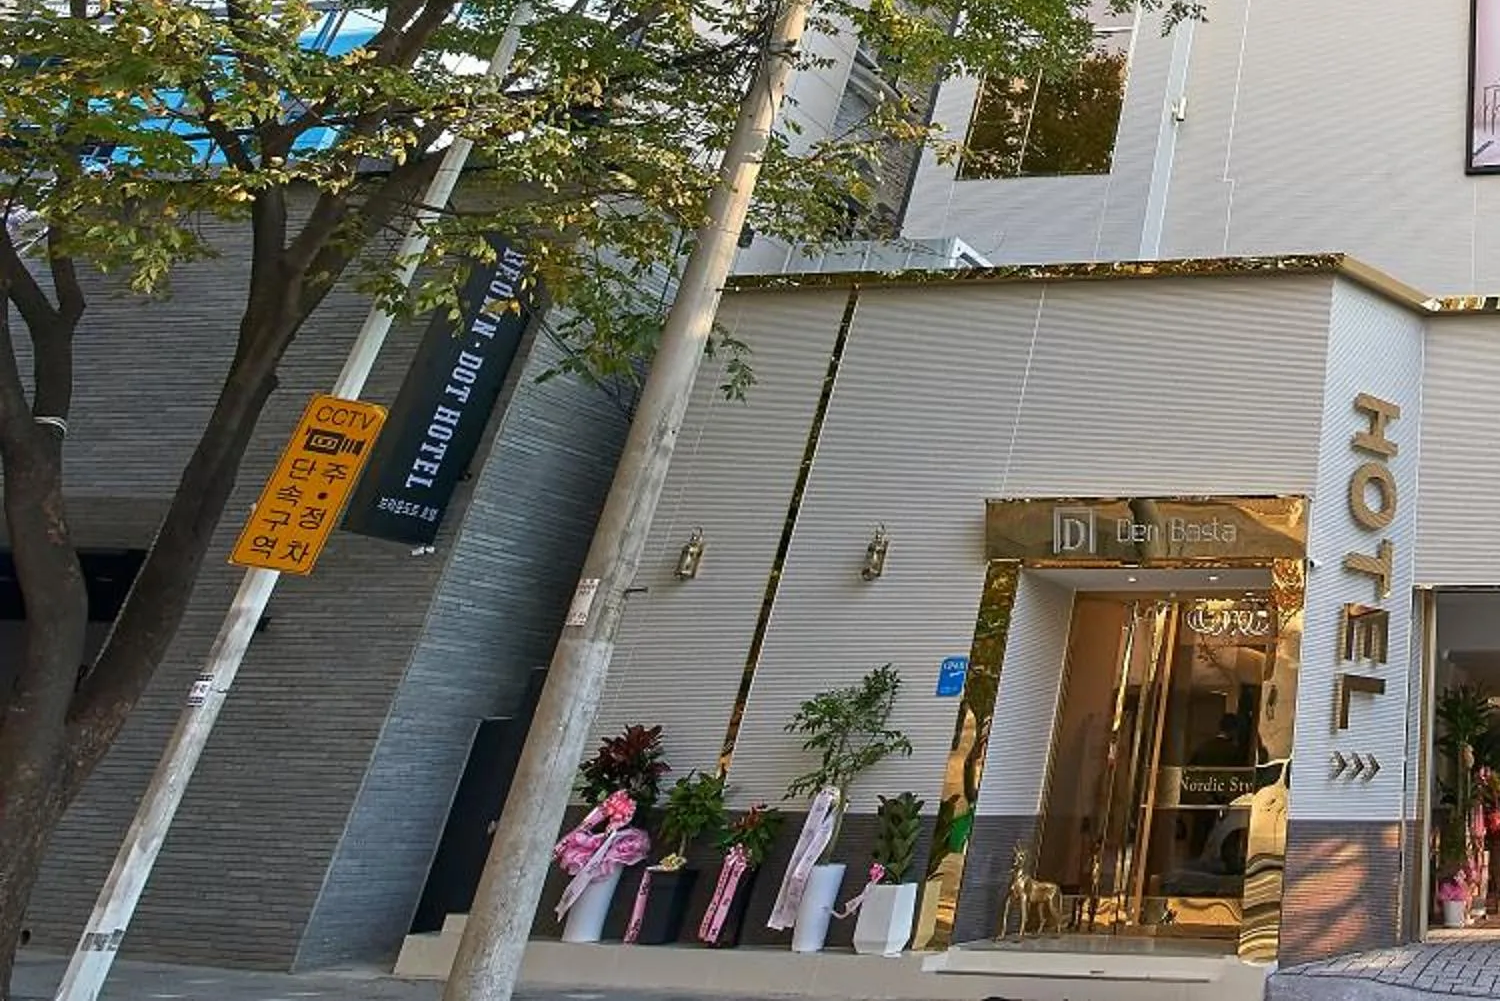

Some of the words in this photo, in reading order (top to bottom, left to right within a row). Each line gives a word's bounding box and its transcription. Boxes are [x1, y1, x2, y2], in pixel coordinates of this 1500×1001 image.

[444, 350, 484, 403] DOT
[315, 404, 379, 431] CCTV
[405, 404, 462, 489] HOTEL
[1116, 517, 1160, 544] Den
[1330, 391, 1401, 734] HOTEL
[1180, 774, 1224, 792] Nordic
